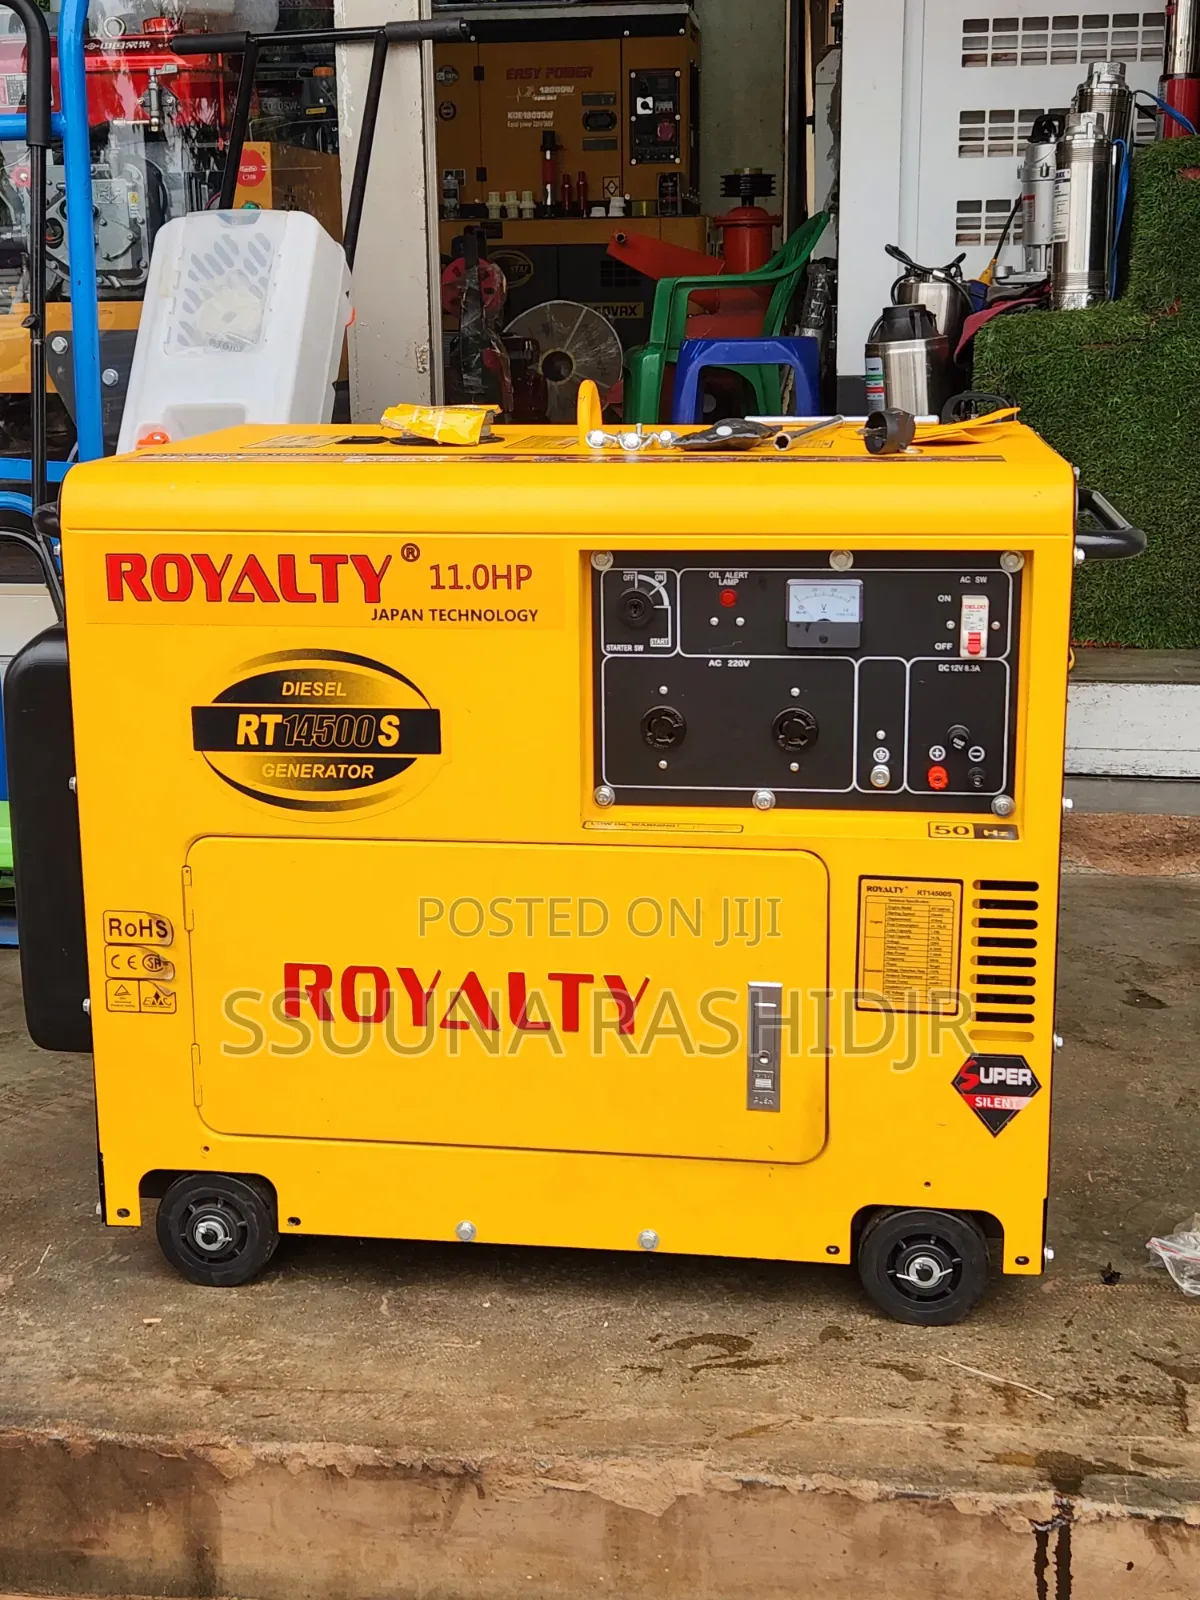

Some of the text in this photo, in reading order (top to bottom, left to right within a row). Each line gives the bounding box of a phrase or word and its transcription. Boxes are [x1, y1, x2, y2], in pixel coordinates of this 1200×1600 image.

[506, 66, 594, 80] EASY POWER
[105, 553, 393, 604] ROYALTY
[429, 564, 533, 590] 11.0HP
[622, 574, 635, 582] OFF
[654, 574, 664, 582] ON
[708, 571, 749, 579] OIL ALERT
[718, 578, 740, 586] LAMP
[937, 594, 952, 602] ON
[371, 608, 538, 622] JAPAN TECHNOLOGY
[650, 637, 669, 645] START
[934, 642, 953, 650] OFF
[605, 644, 633, 652] STARTER
[708, 659, 751, 667] AC 220V
[938, 664, 950, 672] DC
[951, 664, 963, 672] 12V
[281, 681, 348, 697] DIESEL
[236, 713, 401, 748] RT14500S
[261, 763, 375, 780] GENERATOR
[934, 825, 970, 835] 50
[866, 885, 952, 897] ROYALTY RT14500S
[107, 917, 169, 938] RoHS
[284, 962, 651, 1036] ROYALTY
[960, 1060, 1032, 1091] SUPER
[975, 1096, 1018, 1109] SILENT
